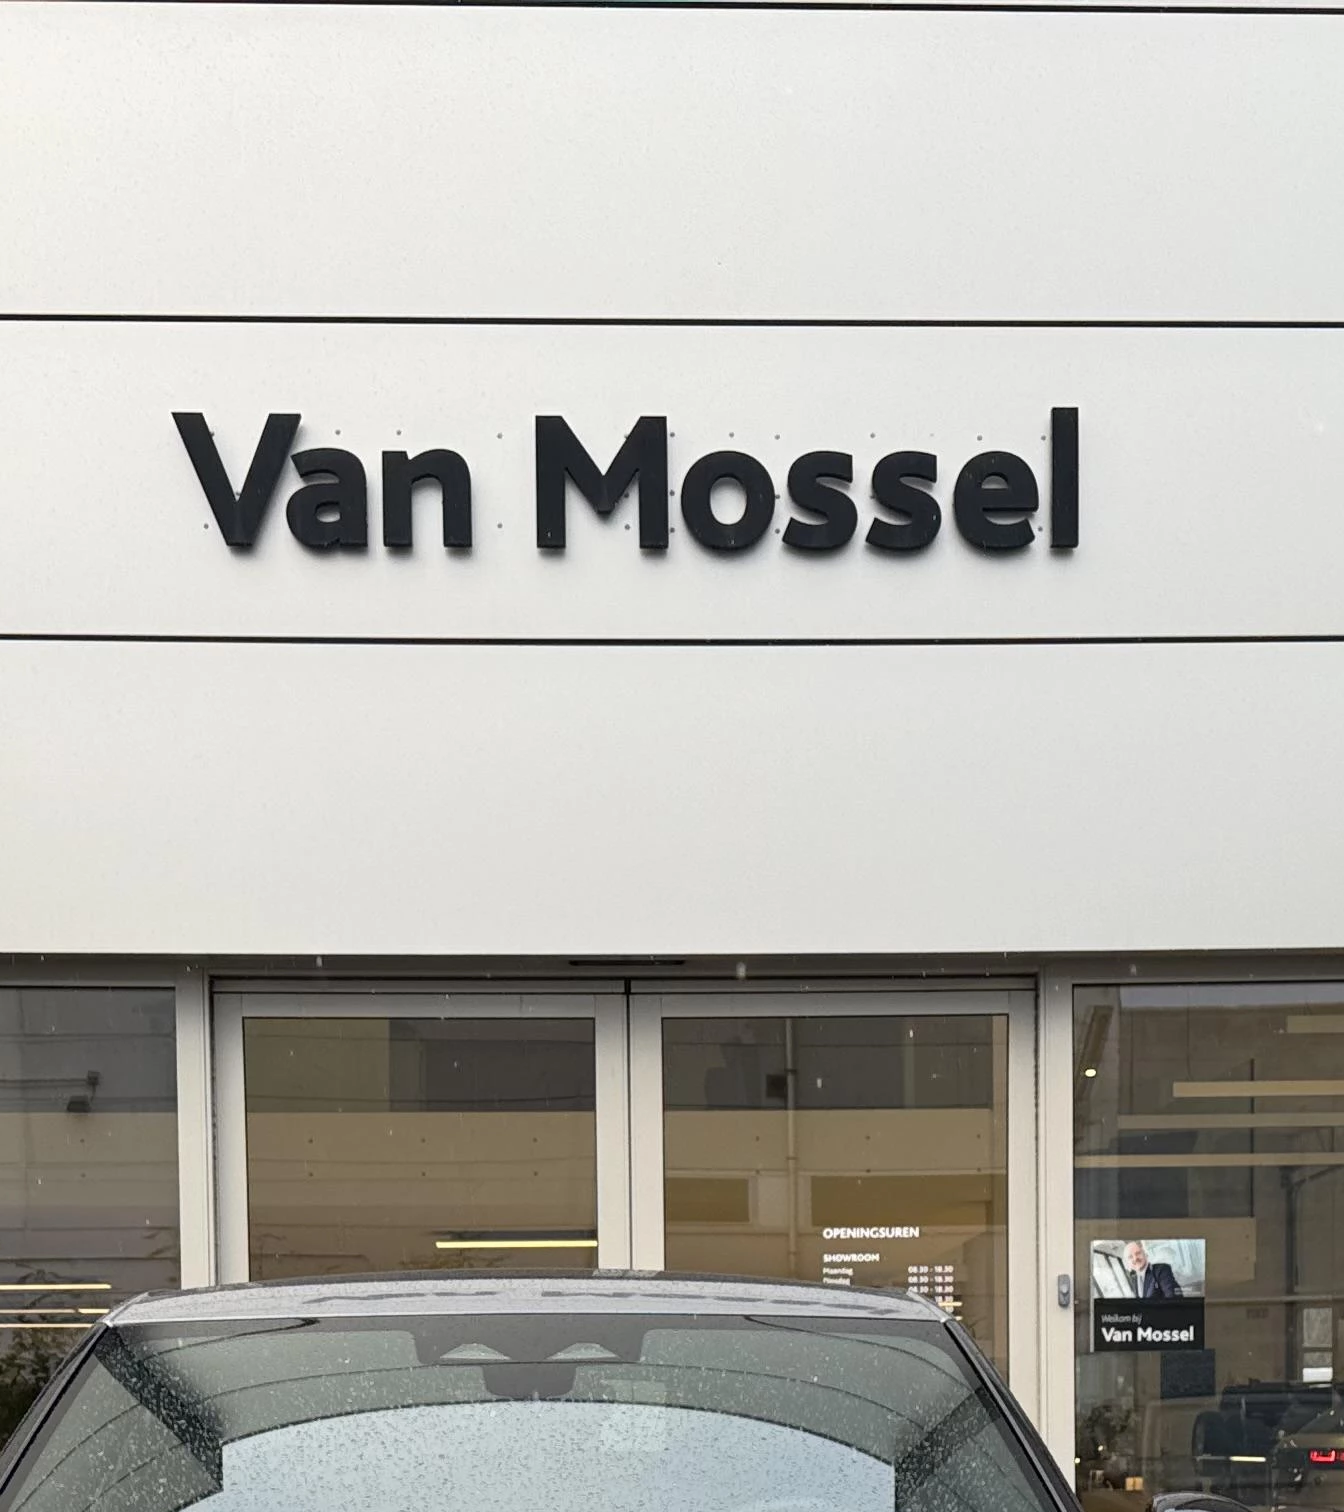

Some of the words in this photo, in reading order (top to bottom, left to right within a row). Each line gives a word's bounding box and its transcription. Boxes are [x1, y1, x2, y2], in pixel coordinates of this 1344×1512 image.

[172, 412, 473, 551] Van
[535, 406, 1079, 552] Mossel
[823, 1227, 920, 1239] OPENINGSUREN
[823, 1253, 880, 1263] SHOWROOM
[1101, 1327, 1133, 1342] Van
[1137, 1325, 1194, 1342] Mossel
